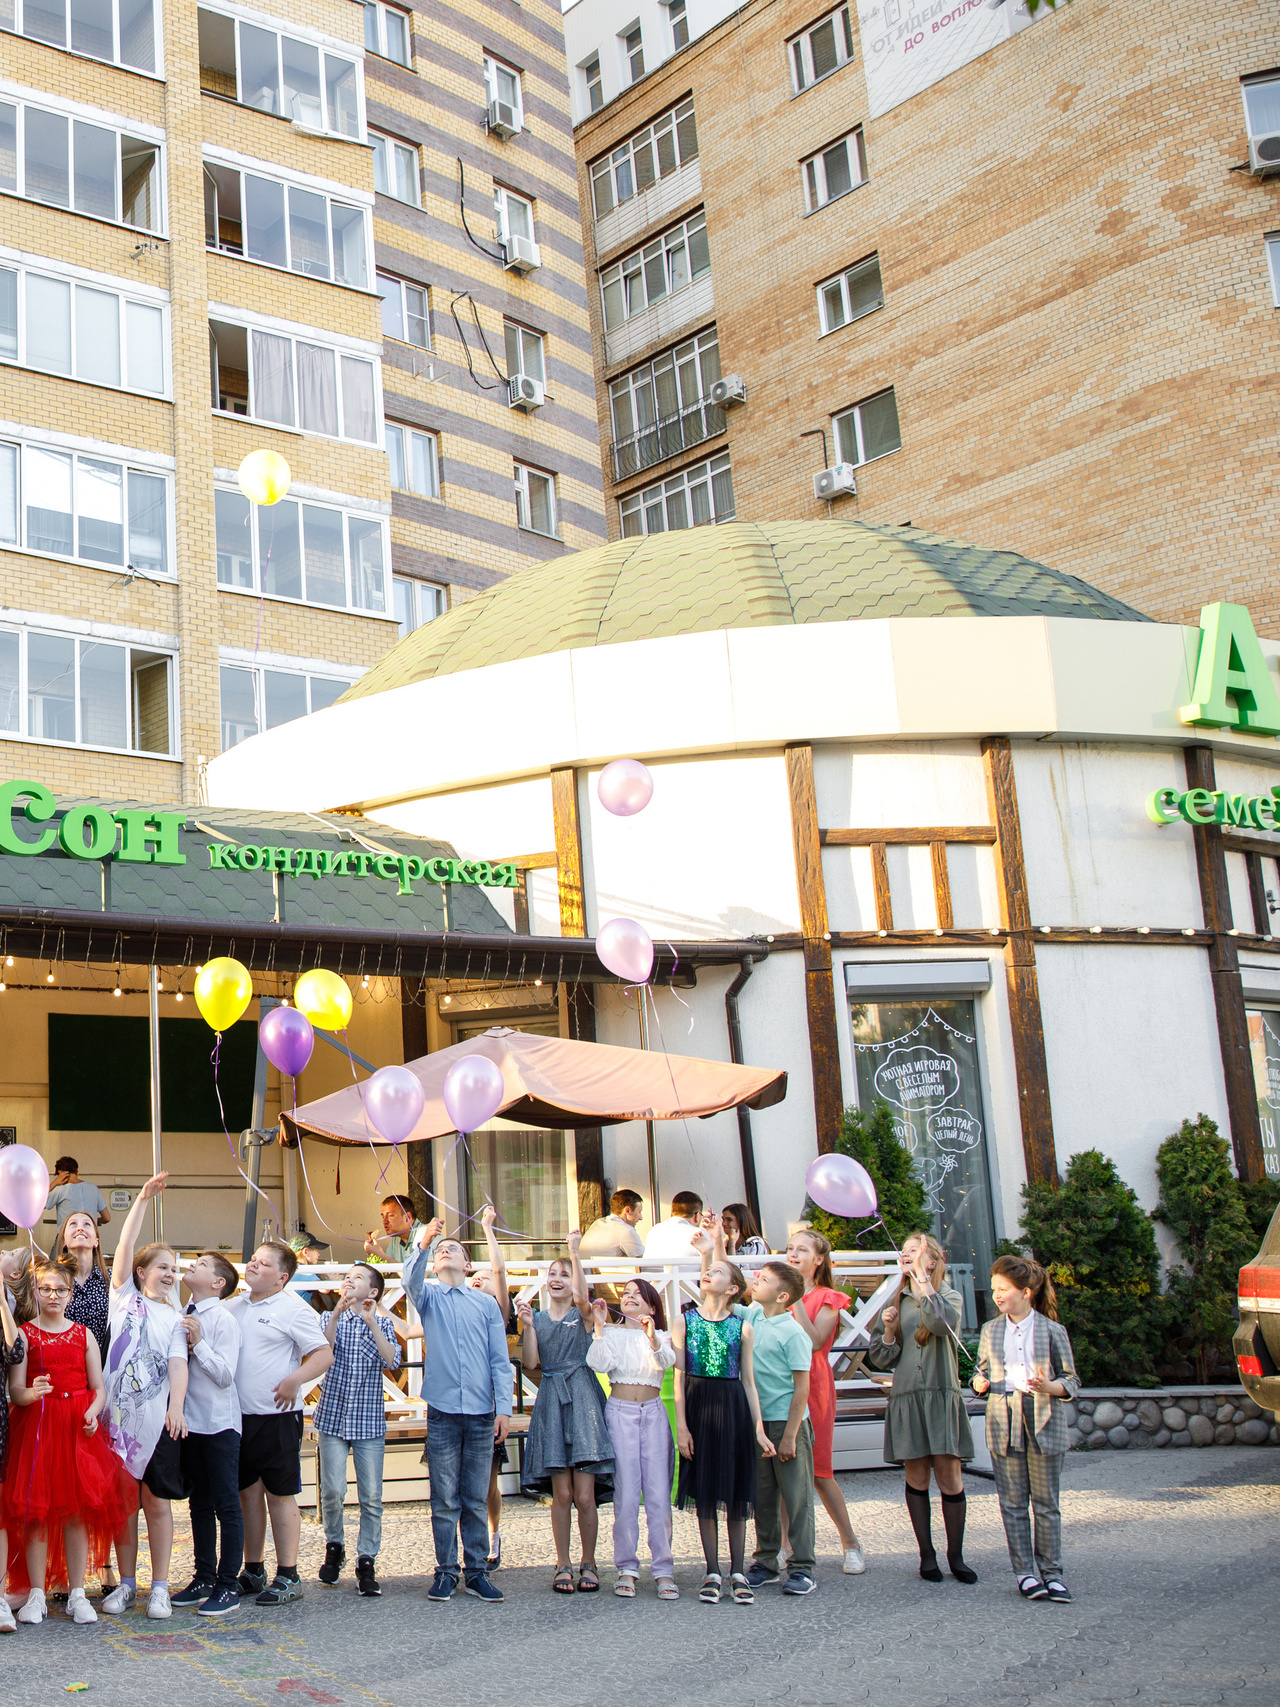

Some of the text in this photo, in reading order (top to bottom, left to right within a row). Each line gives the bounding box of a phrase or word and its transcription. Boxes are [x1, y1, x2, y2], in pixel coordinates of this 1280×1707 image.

[903, 0, 985, 54] ДО ВОПЛО
[872, 32, 892, 53] ОТ
[207, 843, 520, 895] кондитерская
[880, 1059, 951, 1082] УЮТНАЯ ИГРОВАЯ
[895, 1072, 940, 1090] С ВЕСЕЛЫМ
[899, 1085, 945, 1102] АНИМАТОРОМ
[935, 1116, 974, 1131] ЗАВТРАК
[934, 1128, 974, 1145] ЦЕЛЫЙ ДЕНЬ
